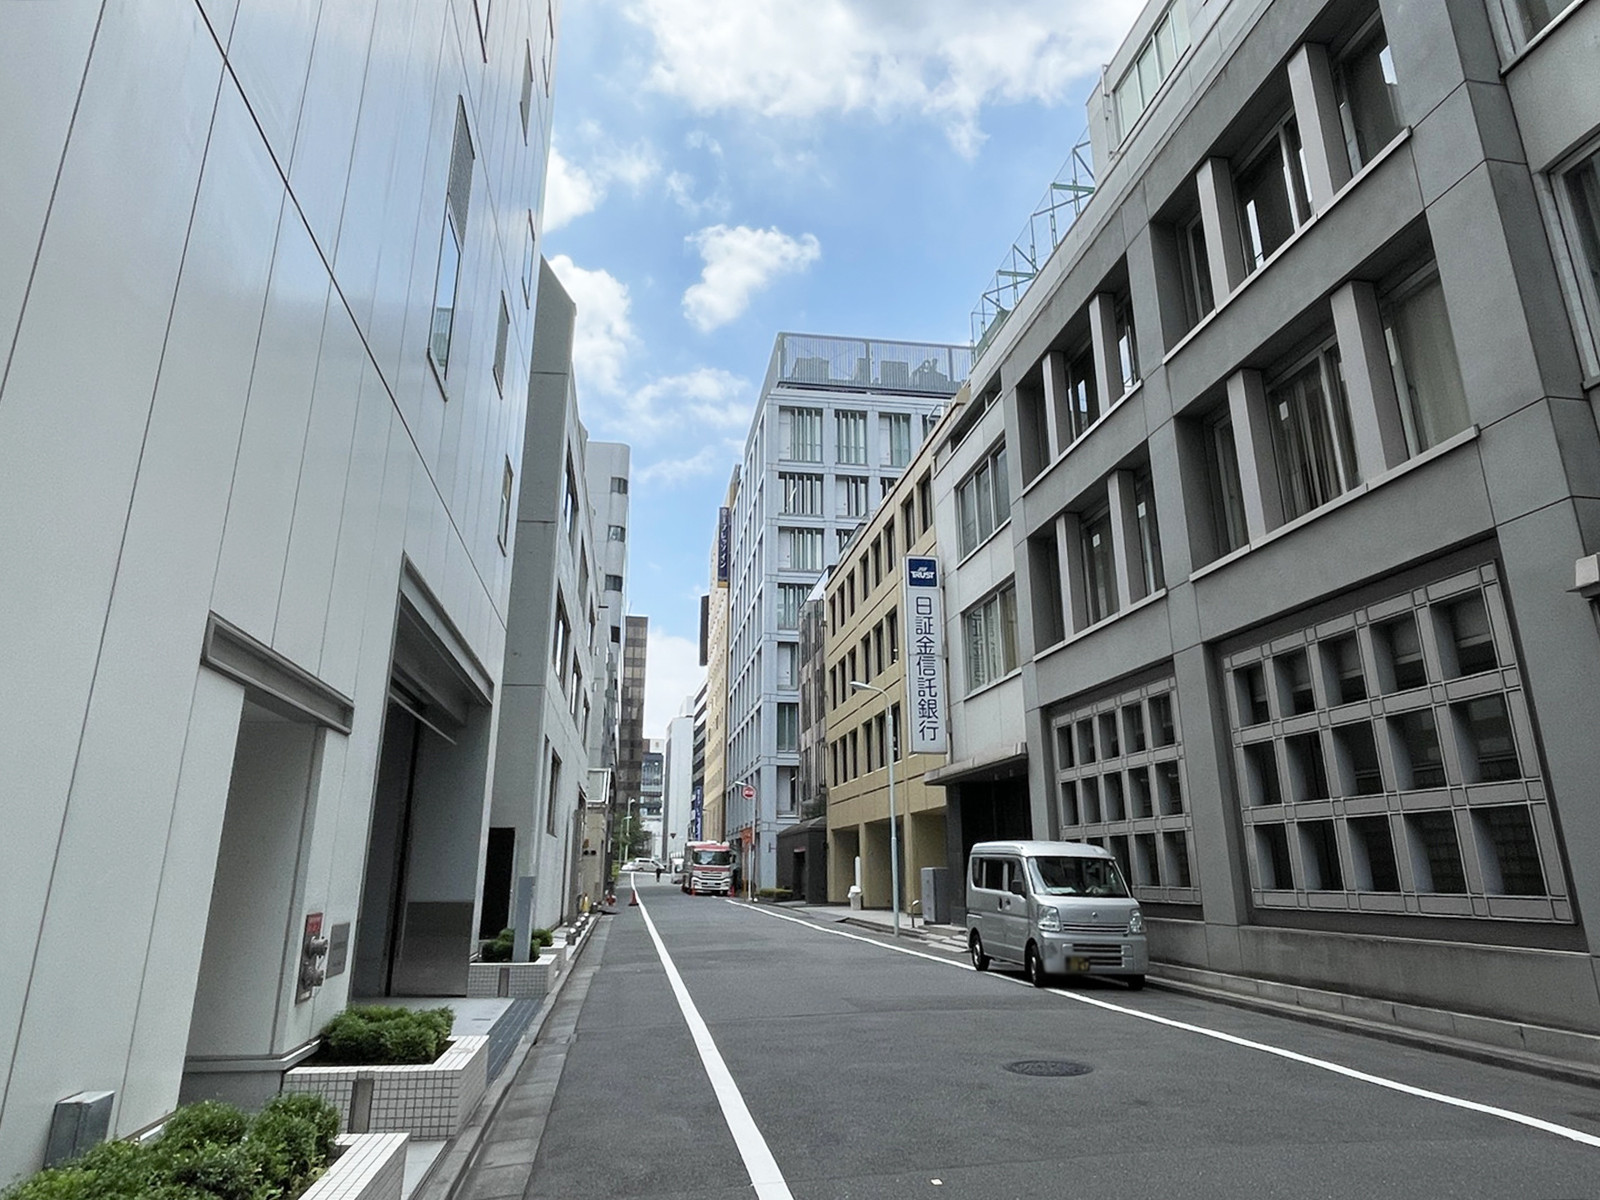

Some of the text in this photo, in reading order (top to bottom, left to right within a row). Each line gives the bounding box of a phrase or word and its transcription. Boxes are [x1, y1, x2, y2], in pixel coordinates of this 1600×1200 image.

[911, 570, 935, 579] TRUST
[915, 596, 939, 741] 日証金信託銀行
